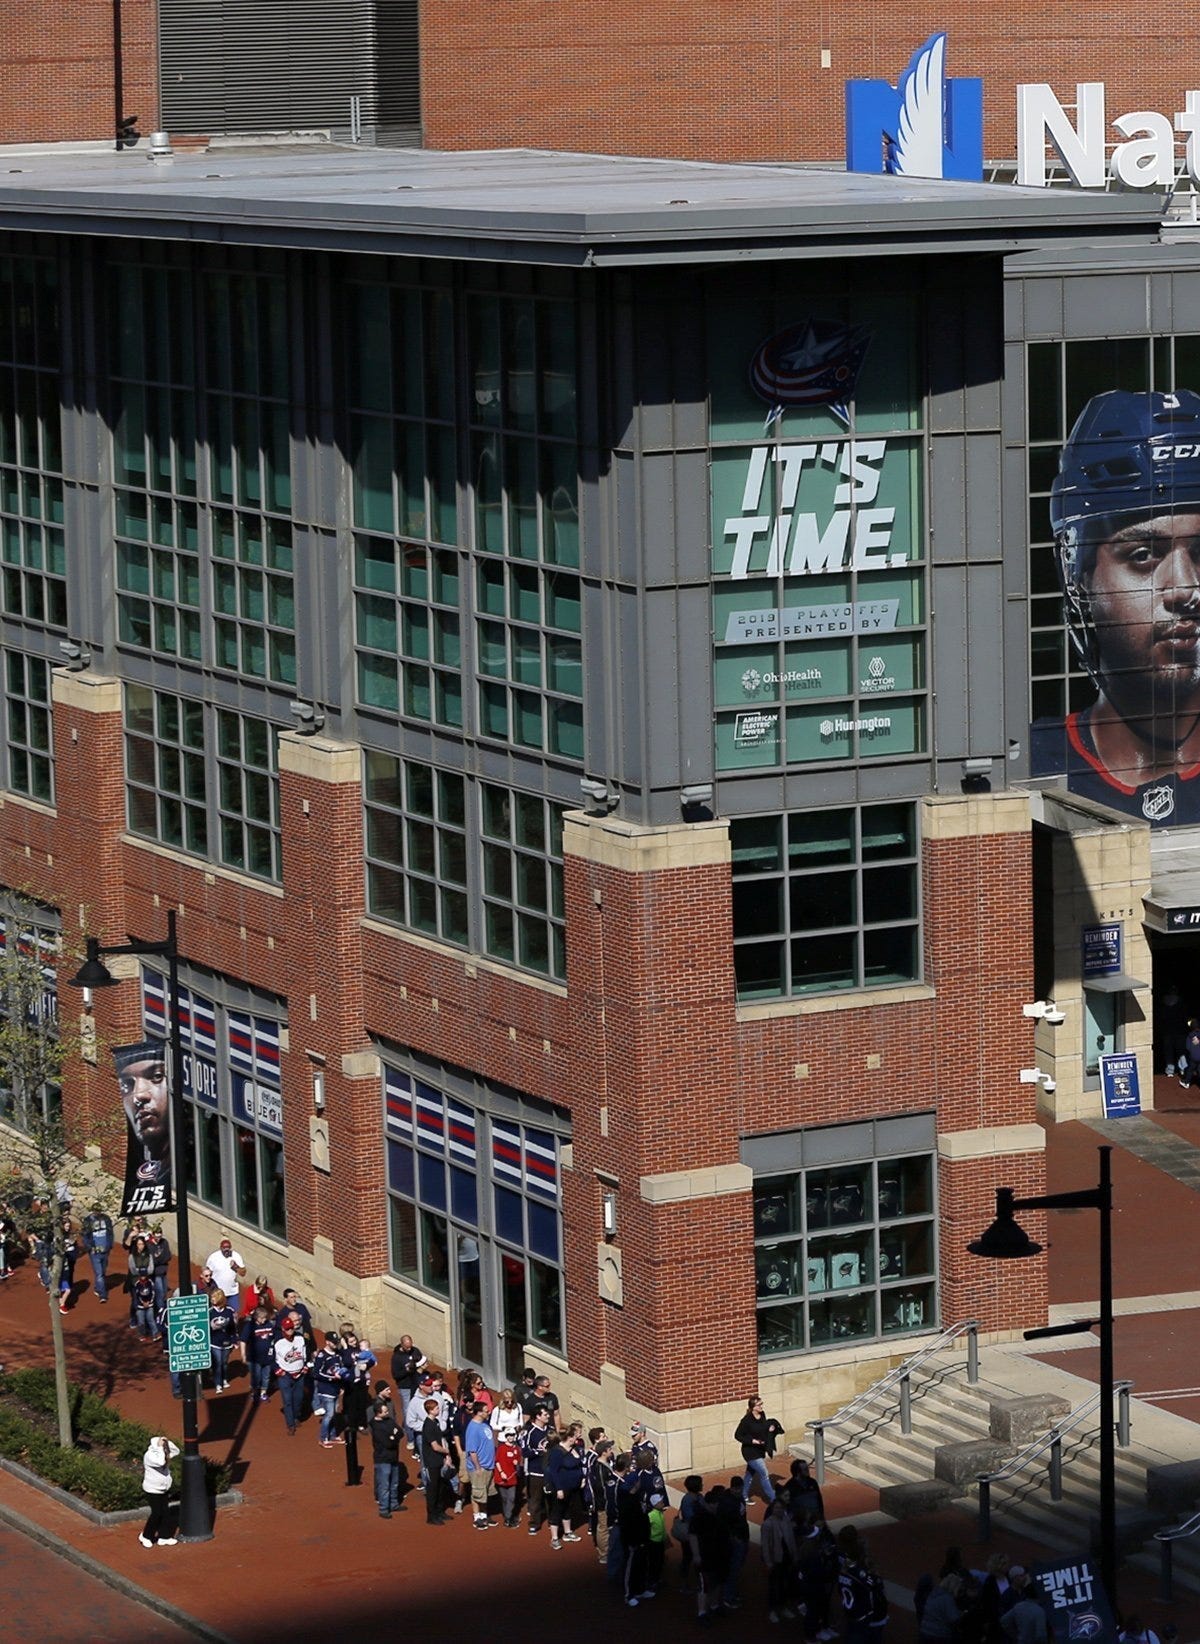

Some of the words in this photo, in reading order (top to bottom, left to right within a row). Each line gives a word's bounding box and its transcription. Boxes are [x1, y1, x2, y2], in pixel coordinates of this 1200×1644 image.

[741, 440, 887, 511] IT'S
[723, 507, 908, 580] TIME.
[737, 613, 776, 625] 2019
[797, 604, 890, 620] PLAYOFFS
[745, 621, 848, 638] PRESENTED
[861, 618, 881, 629] BY
[743, 714, 778, 723] AMERICAN
[741, 728, 766, 736] POWER
[1084, 931, 1118, 943] REMINDER
[131, 1185, 165, 1201] IT'S
[173, 1345, 186, 1353] BIKE
[188, 1343, 207, 1351] ROUTE
[1036, 1563, 1094, 1592] TIME.
[1052, 1582, 1093, 1609] IT'S
